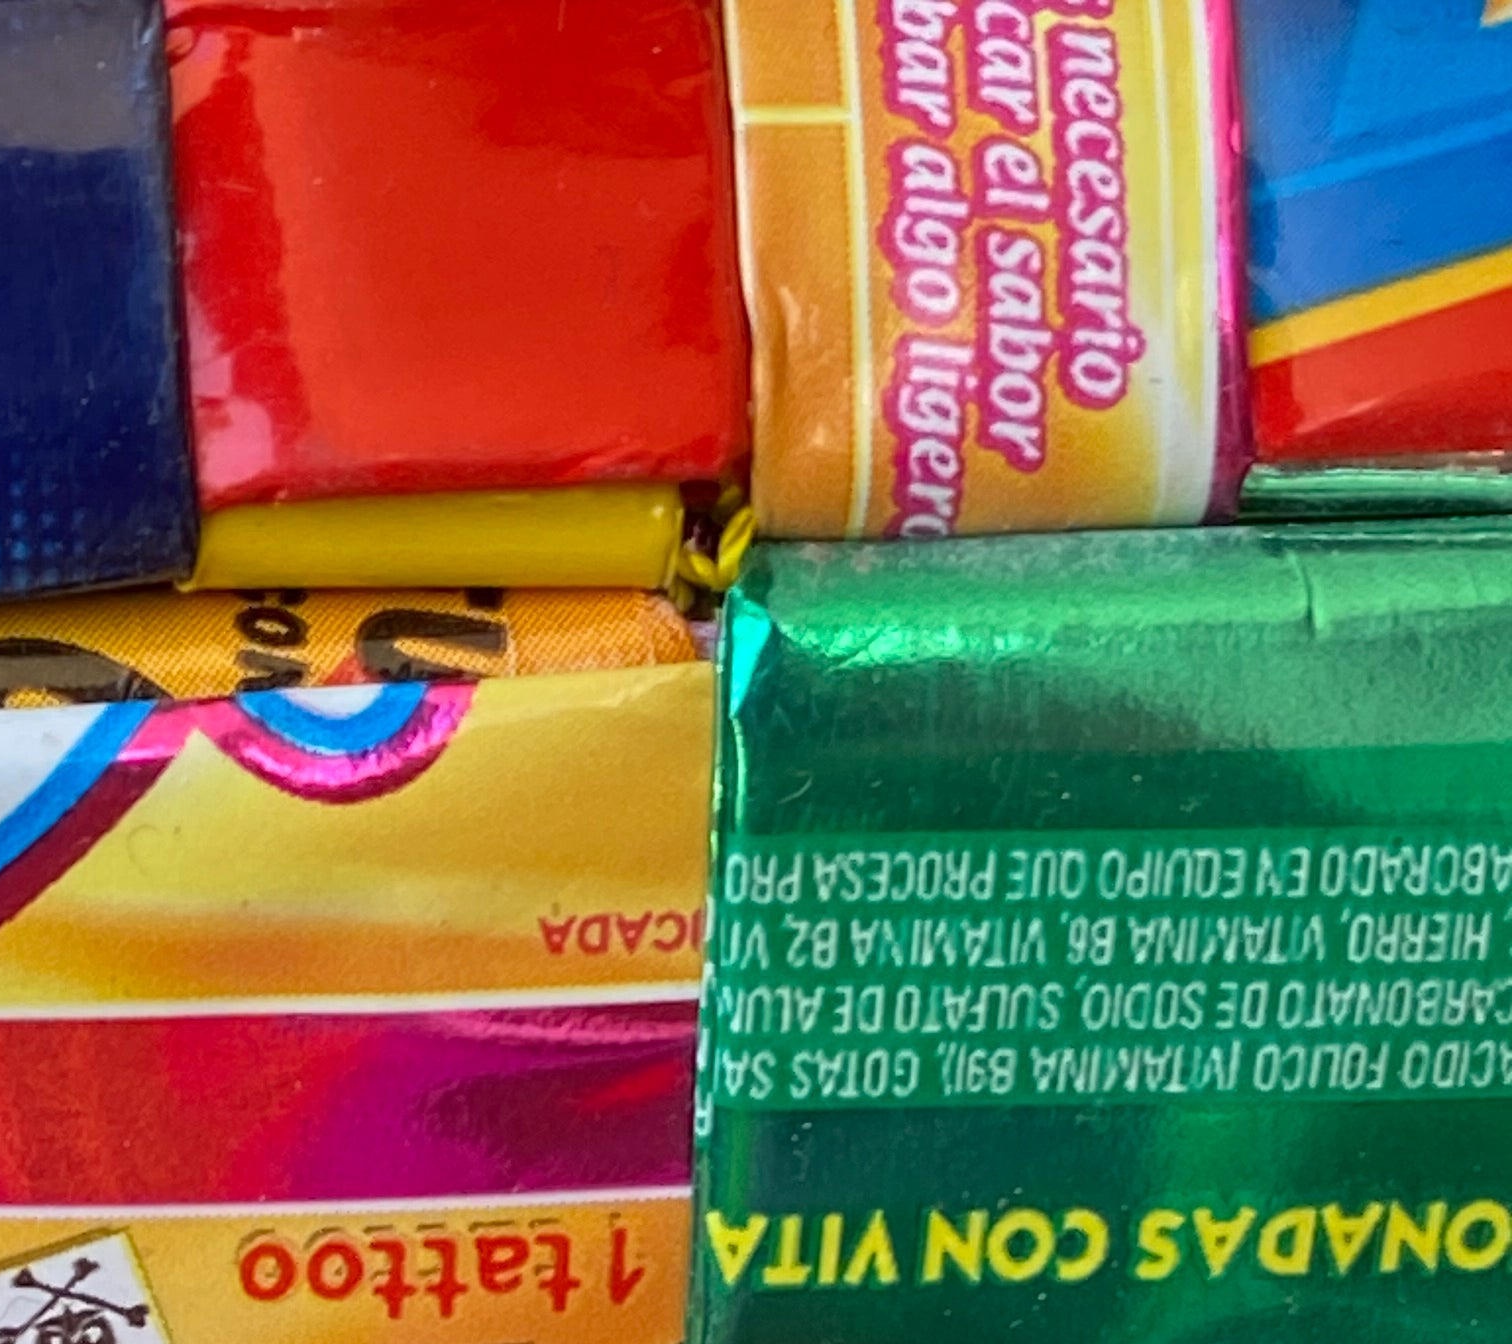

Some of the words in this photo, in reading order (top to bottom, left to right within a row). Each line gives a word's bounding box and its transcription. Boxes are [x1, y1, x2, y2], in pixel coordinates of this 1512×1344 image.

[984, 142, 1049, 216] el
[893, 144, 969, 315] algo
[1062, 32, 1138, 399] necesario
[984, 231, 1052, 464] sabor
[814, 849, 1000, 903] PROCESA
[1004, 849, 1088, 902] QUE
[1099, 848, 1249, 901] EQUIPO
[1255, 846, 1310, 899] EN
[850, 914, 1048, 967] VITAMINA
[1131, 911, 1326, 964] VITAMINA
[1339, 909, 1493, 963] HIERRO,
[832, 984, 886, 1032] DE
[892, 981, 1065, 1032] SULFATO
[1078, 980, 1207, 1030] SODIO,
[1215, 980, 1266, 1028] DE
[790, 1048, 921, 1097] GOTAS
[1253, 1043, 1390, 1090] FOLICO
[705, 1209, 900, 1288] VITA
[920, 1207, 1110, 1285] CON
[238, 1232, 582, 1320] tattoo
